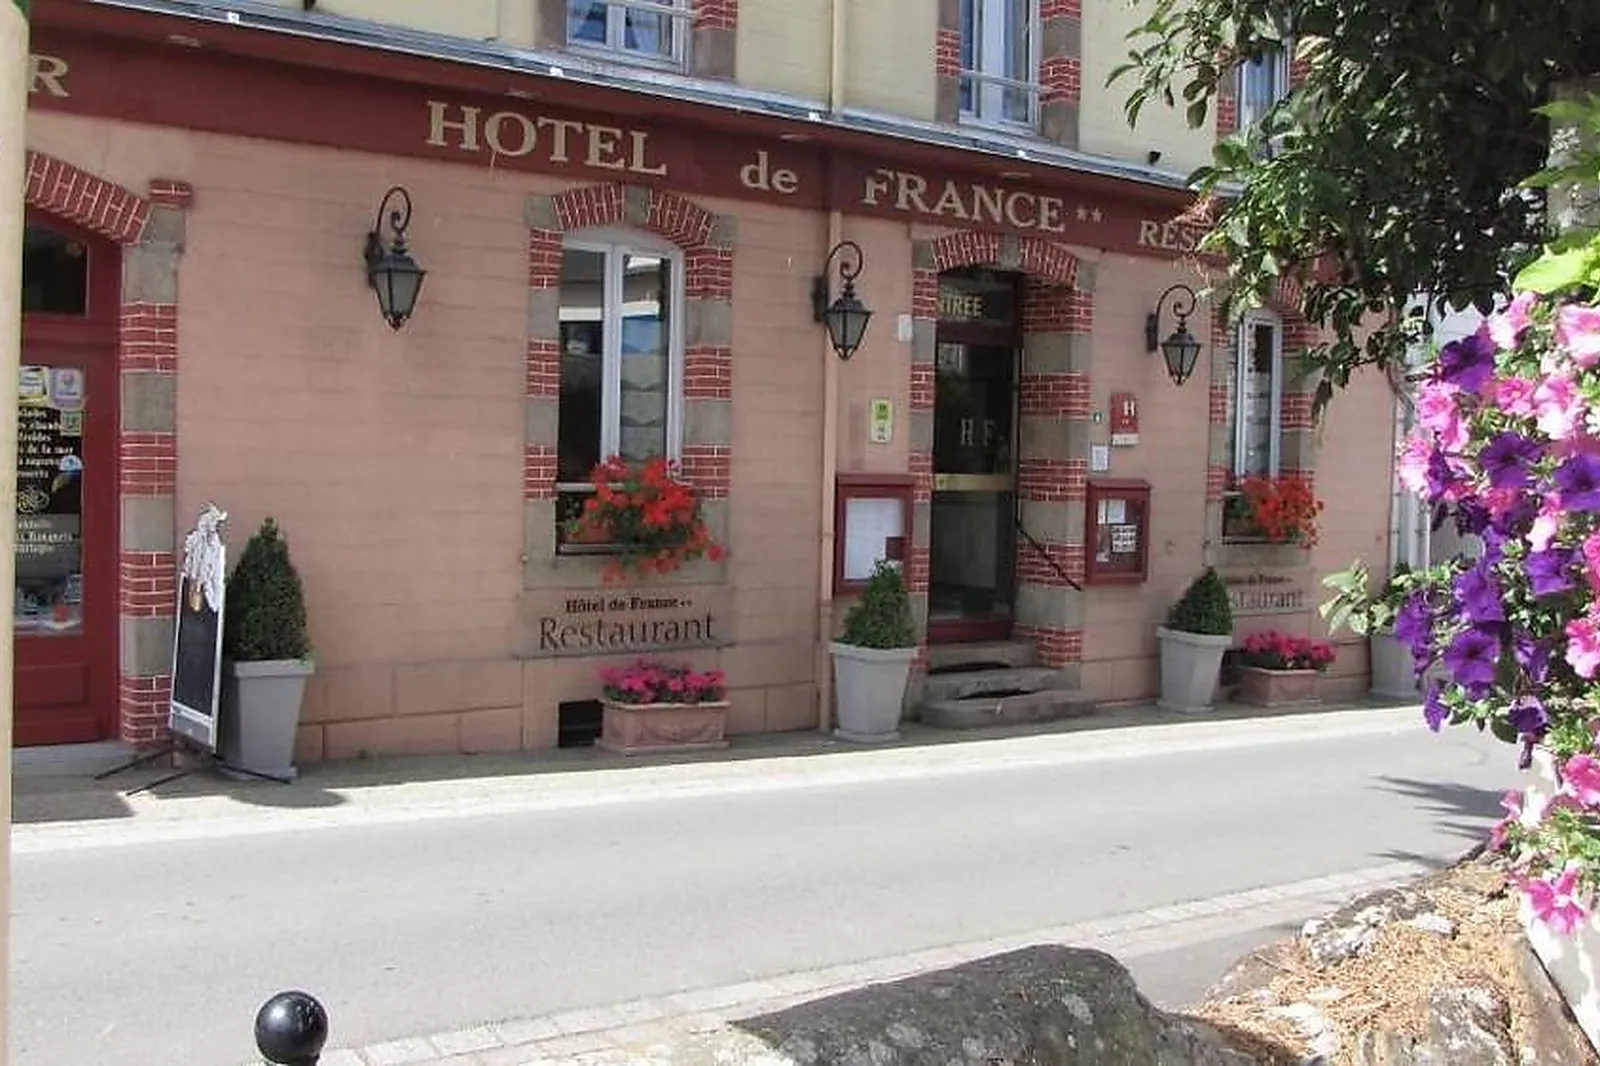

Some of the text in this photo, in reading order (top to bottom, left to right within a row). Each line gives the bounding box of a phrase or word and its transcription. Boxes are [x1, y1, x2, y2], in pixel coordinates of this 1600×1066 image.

[425, 100, 1066, 233] HOTEL de FRANCE
[1138, 220, 1200, 252] RES
[539, 612, 715, 650] Restaurant
